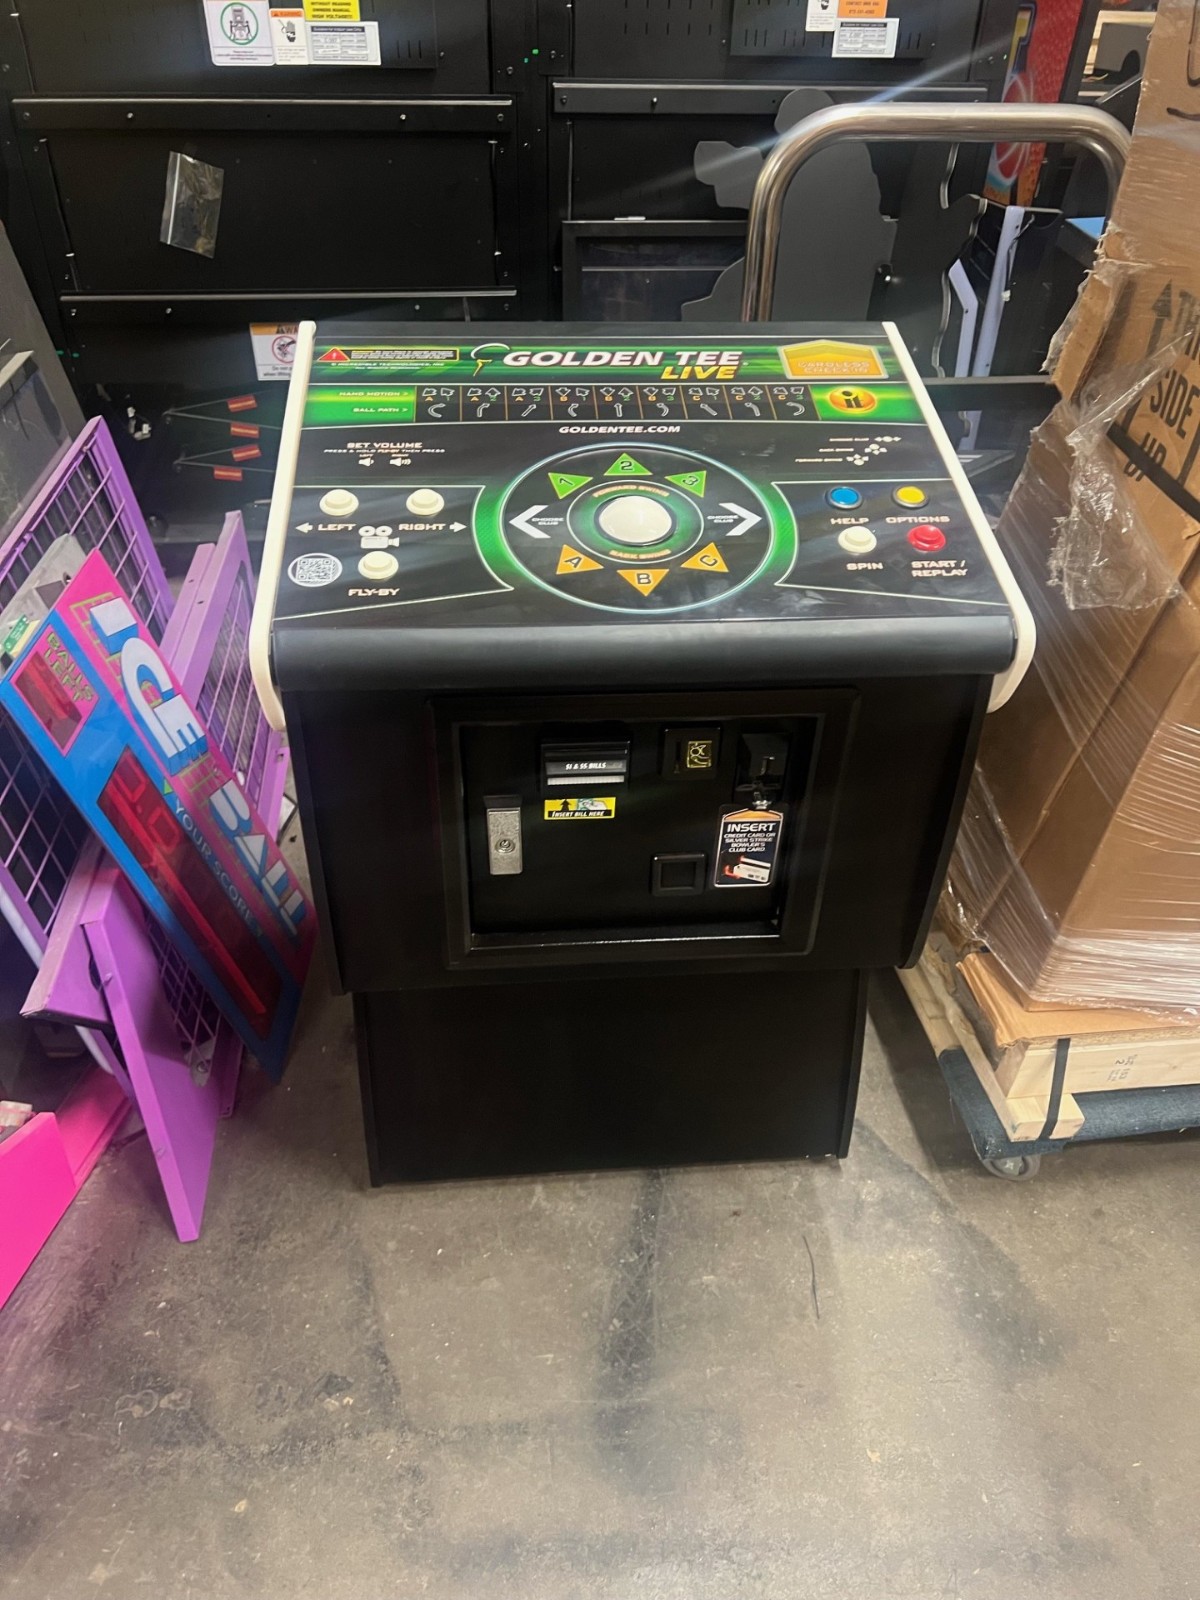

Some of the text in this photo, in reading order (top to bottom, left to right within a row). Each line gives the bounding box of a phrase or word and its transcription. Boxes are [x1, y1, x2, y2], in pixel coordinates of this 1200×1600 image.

[503, 350, 743, 367] GOLDEN TEE
[661, 366, 737, 379] LIVE
[1150, 369, 1200, 440] SIDE
[558, 425, 681, 434] GOLDENTEE.COM
[620, 461, 633, 471] 2
[560, 478, 573, 486] 1
[682, 475, 699, 486] 3
[830, 517, 870, 525] HELP
[885, 516, 951, 524] OPTIONS
[317, 523, 356, 531] LEFT
[398, 523, 446, 531] RIGHT
[564, 555, 582, 568] A
[699, 554, 718, 567] C
[911, 560, 957, 569] START
[846, 562, 883, 571] SPIN
[911, 568, 968, 578] REPLAY
[636, 573, 652, 585] B
[348, 588, 400, 597] FLY-BY
[47, 631, 93, 702] BALLS
[44, 648, 83, 702] LEFT
[90, 597, 306, 937] ICE BALL
[589, 761, 607, 769] BILLS
[552, 810, 573, 818] INSERT
[727, 822, 776, 832] INSERT
[174, 797, 258, 922] YOUR SCORE
